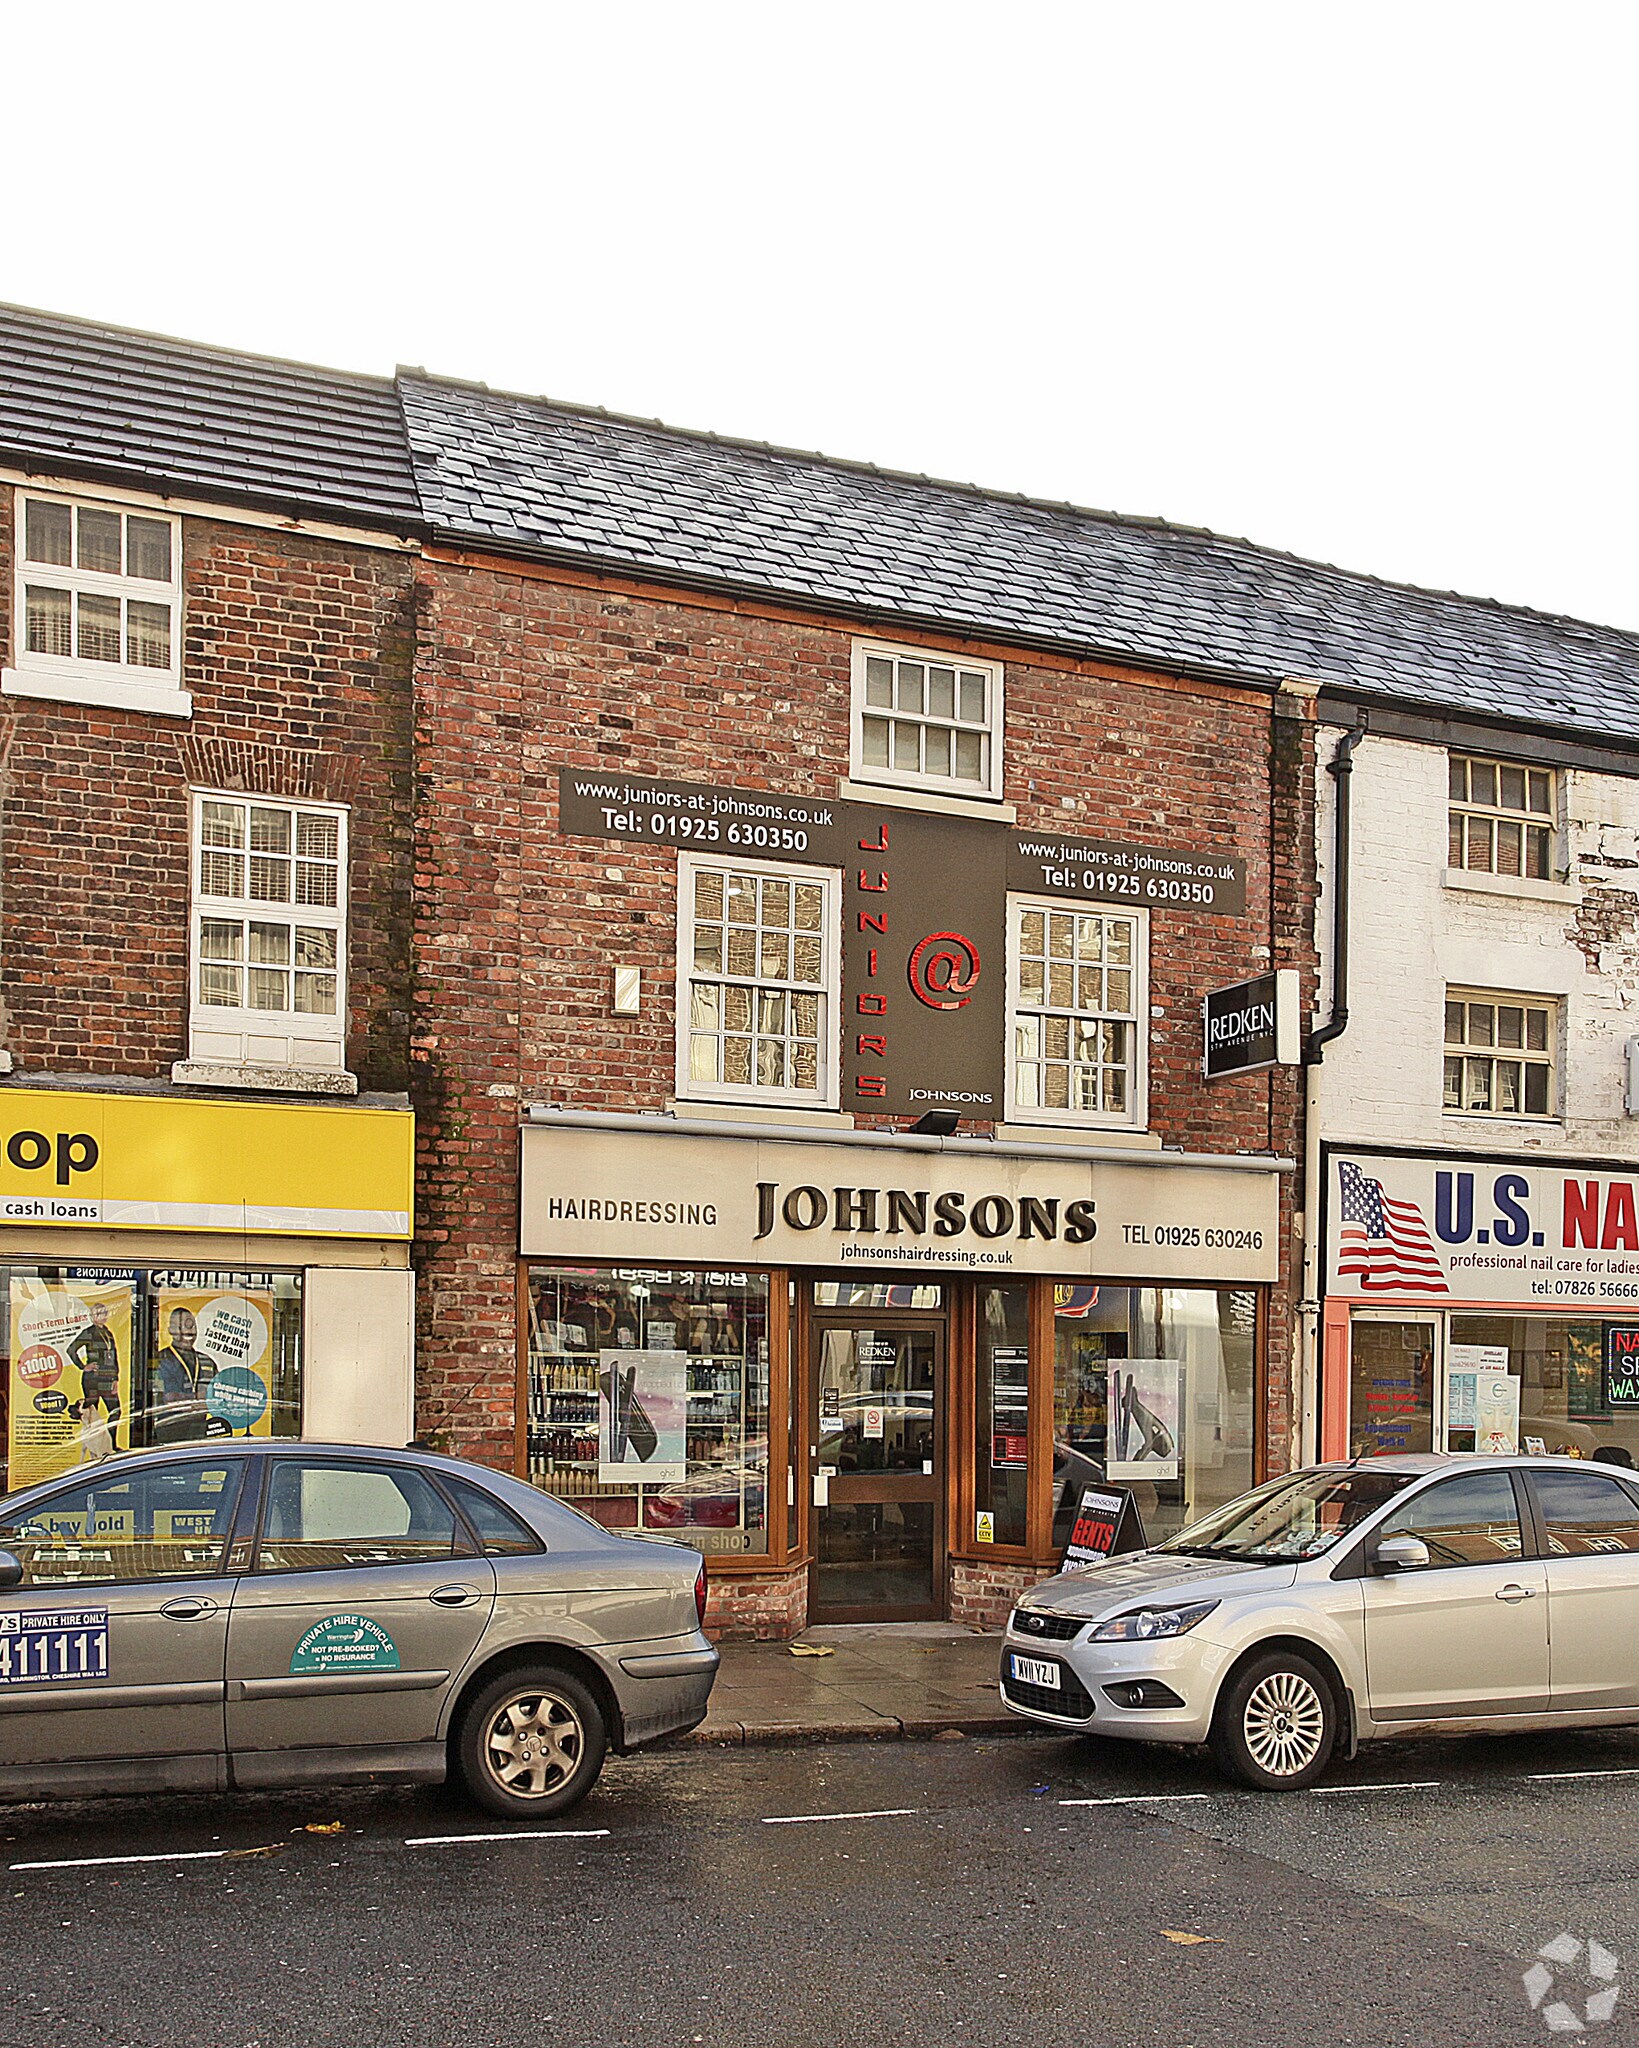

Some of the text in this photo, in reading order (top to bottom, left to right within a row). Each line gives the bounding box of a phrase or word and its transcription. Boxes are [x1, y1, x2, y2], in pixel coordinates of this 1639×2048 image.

[574, 781, 833, 827] www.juniors-at-johnsons.co.uk
[601, 808, 808, 851] Tel: 01925 630350
[1018, 842, 1235, 881] www.juniors-at-johnsons.co.uk
[1041, 865, 1214, 904] Tel: 01925 630350
[857, 823, 889, 1097] JUNIORS
[908, 931, 981, 1010] @
[1210, 1001, 1274, 1043] REDKEN
[1210, 1028, 1274, 1052] 5TH AVENUE NYC
[909, 1087, 993, 1104] JOHNSONS
[0, 1131, 99, 1186] op
[5, 1200, 98, 1218] cash loans
[549, 1182, 1263, 1251] HAIRDRESSING JOHNSONS TEL 01925 630246
[1435, 1171, 1545, 1247] U.S.
[840, 1243, 1014, 1266] johnsonshairdressing.co.uk
[1450, 1252, 1639, 1275] professional nail care for ladies
[1531, 1280, 1552, 1295] tel:
[1555, 1281, 1595, 1296] 07826
[212, 1318, 250, 1339] cheques
[217, 1309, 253, 1329] we cash
[205, 1328, 230, 1343] faster
[205, 1339, 243, 1358] any bank
[859, 1346, 896, 1357] REDKEN
[659, 1468, 676, 1480] ghd
[1156, 1465, 1170, 1476] ghd
[1084, 1495, 1119, 1509] JOHNSONS
[711, 1531, 751, 1554] shop
[1071, 1517, 1115, 1552] GENTS
[22, 1616, 59, 1628] PRIVATE
[60, 1615, 82, 1627] HIRE
[83, 1613, 106, 1625] ONLY
[297, 1615, 394, 1656] PRIVATE HIRE VEHICLE
[311, 1644, 380, 1654] NOT PRE-BOOKED?
[333, 1653, 376, 1661] INSURANCE
[52, 1672, 81, 1680] CHESHIRE
